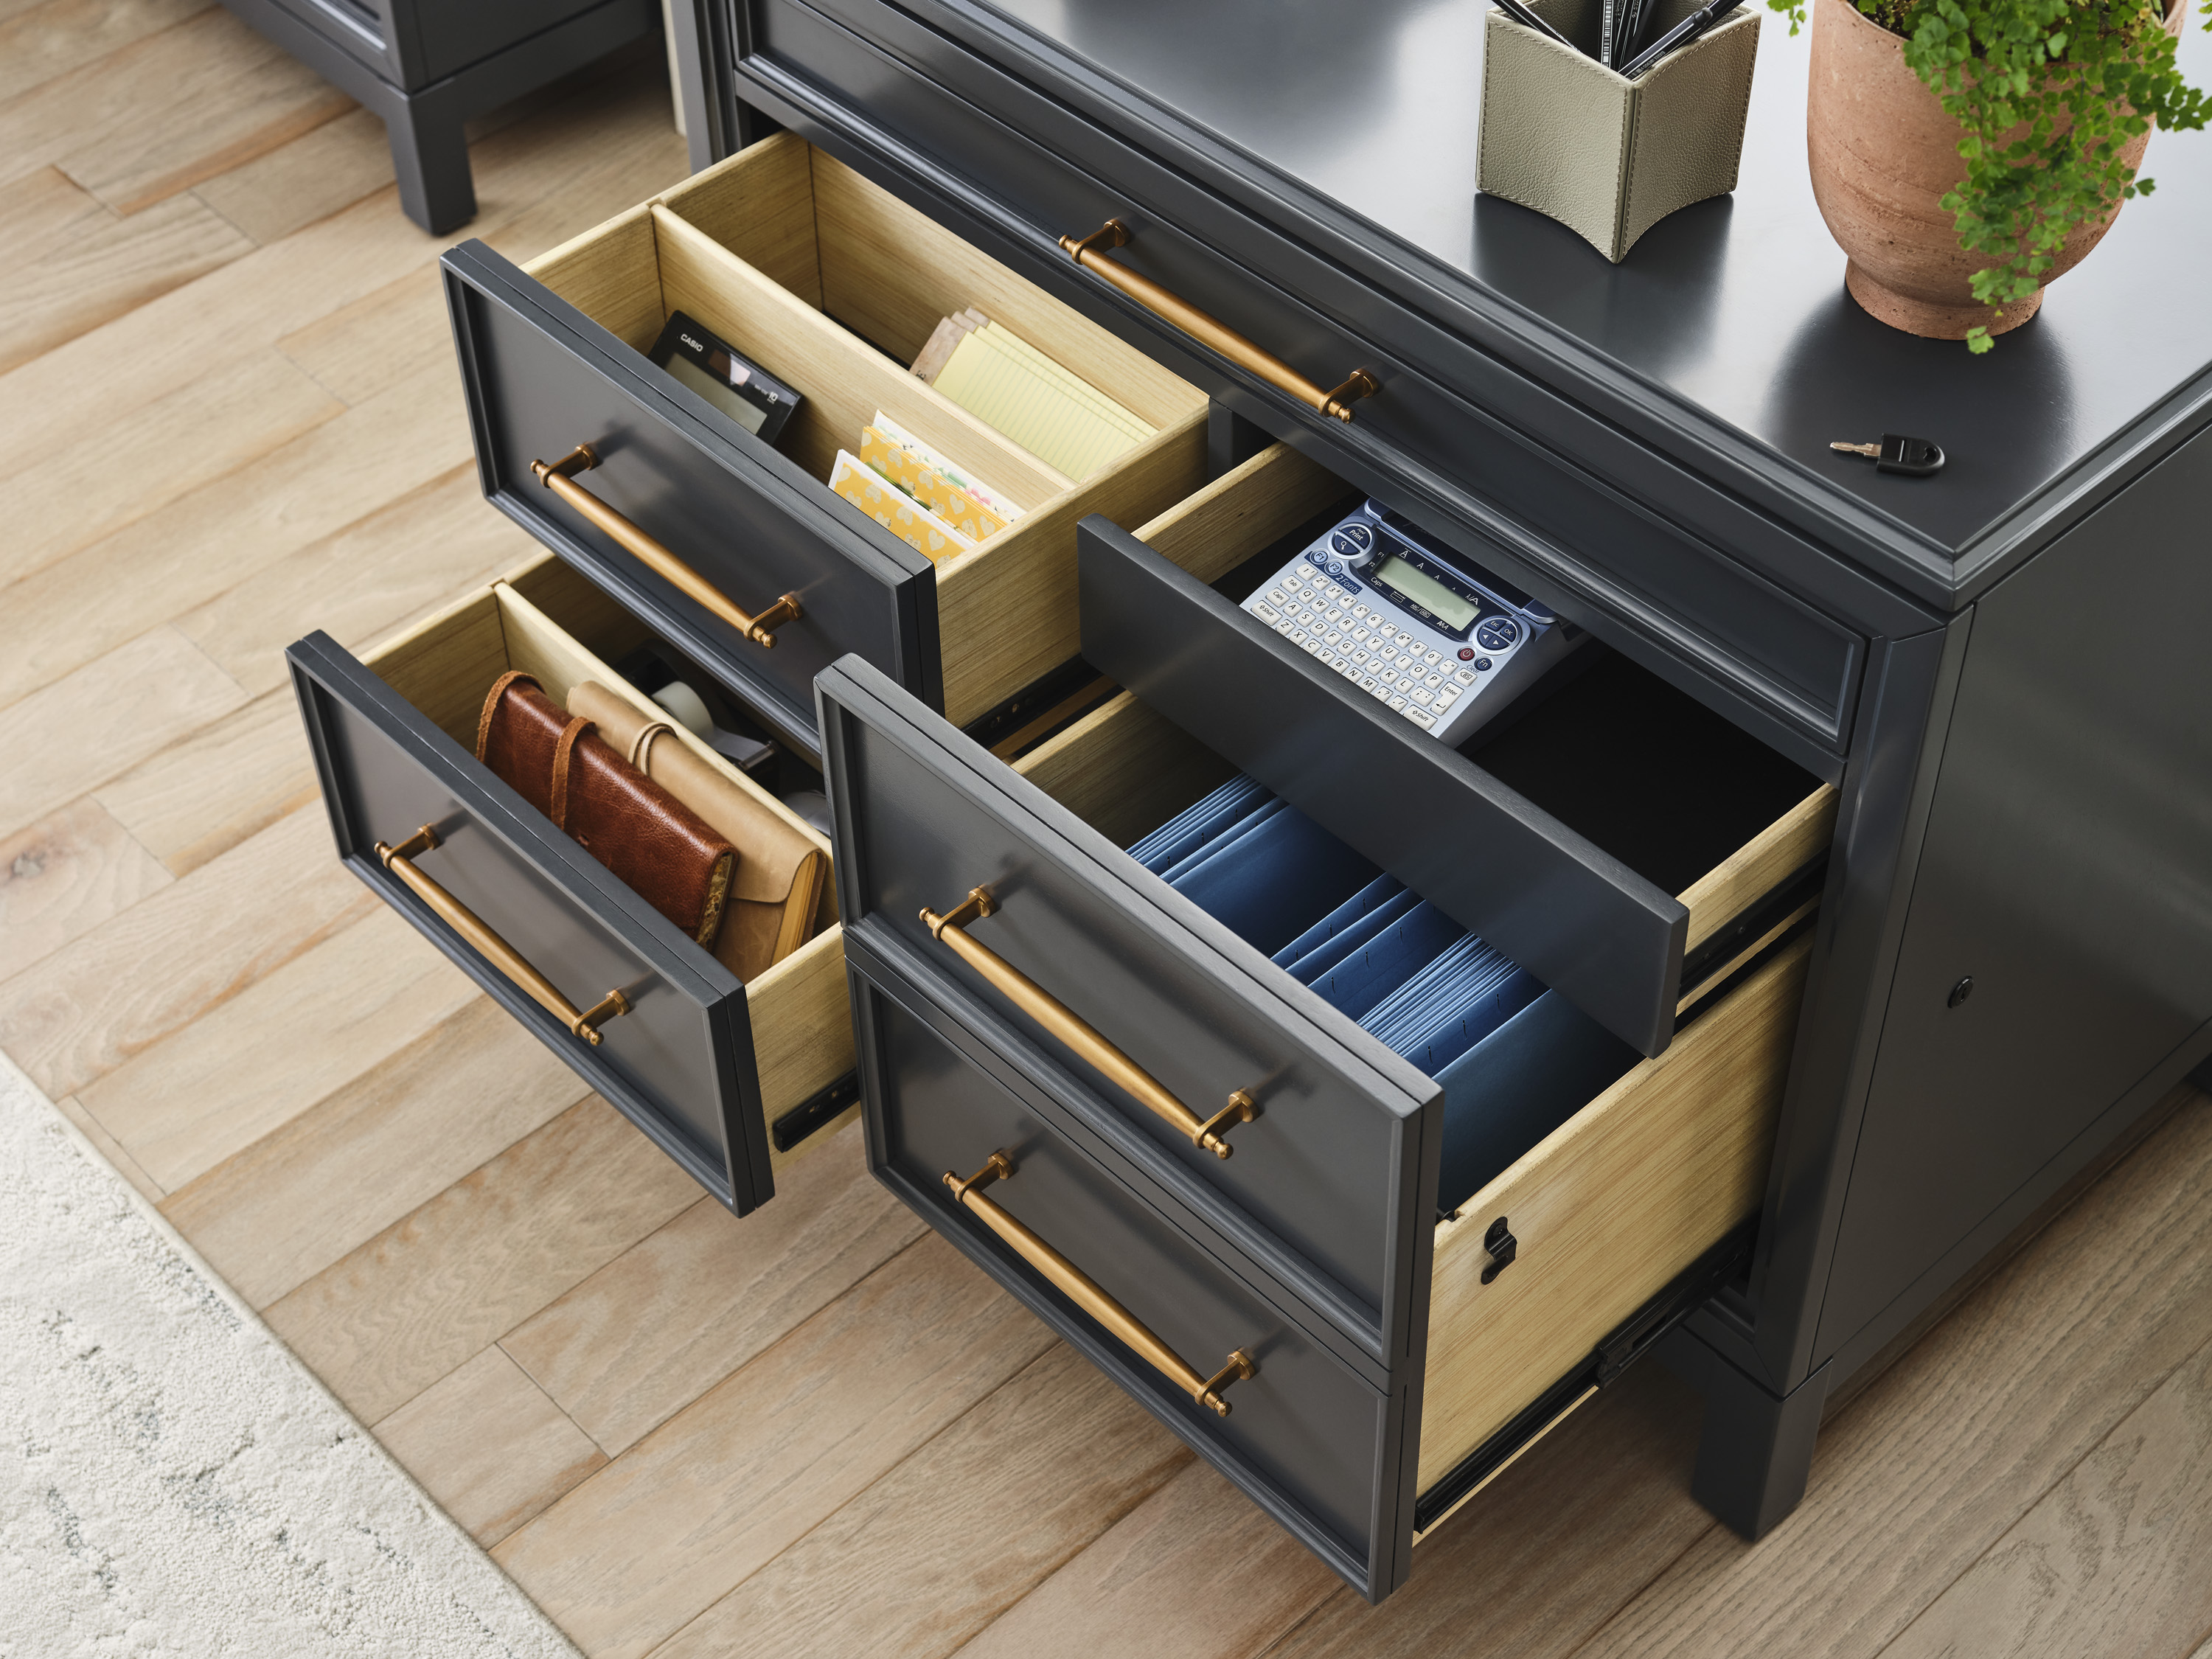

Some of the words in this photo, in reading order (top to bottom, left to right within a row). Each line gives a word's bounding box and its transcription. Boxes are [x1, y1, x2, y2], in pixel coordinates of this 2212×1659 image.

[680, 333, 703, 352] CASIO
[768, 392, 779, 402] 10
[1349, 529, 1363, 541] Print
[1315, 552, 1324, 561] F1
[1329, 563, 1339, 571] F2
[1289, 579, 1297, 587] Tab
[1371, 577, 1383, 587] Caps
[1273, 591, 1284, 600] Caps
[1262, 607, 1274, 617] Shift
[1479, 659, 1488, 667] Fn
[1466, 664, 1480, 674] Clear
[1363, 679, 1373, 687] M
[1444, 686, 1458, 696] Enter
[1416, 712, 1429, 722] Shift
